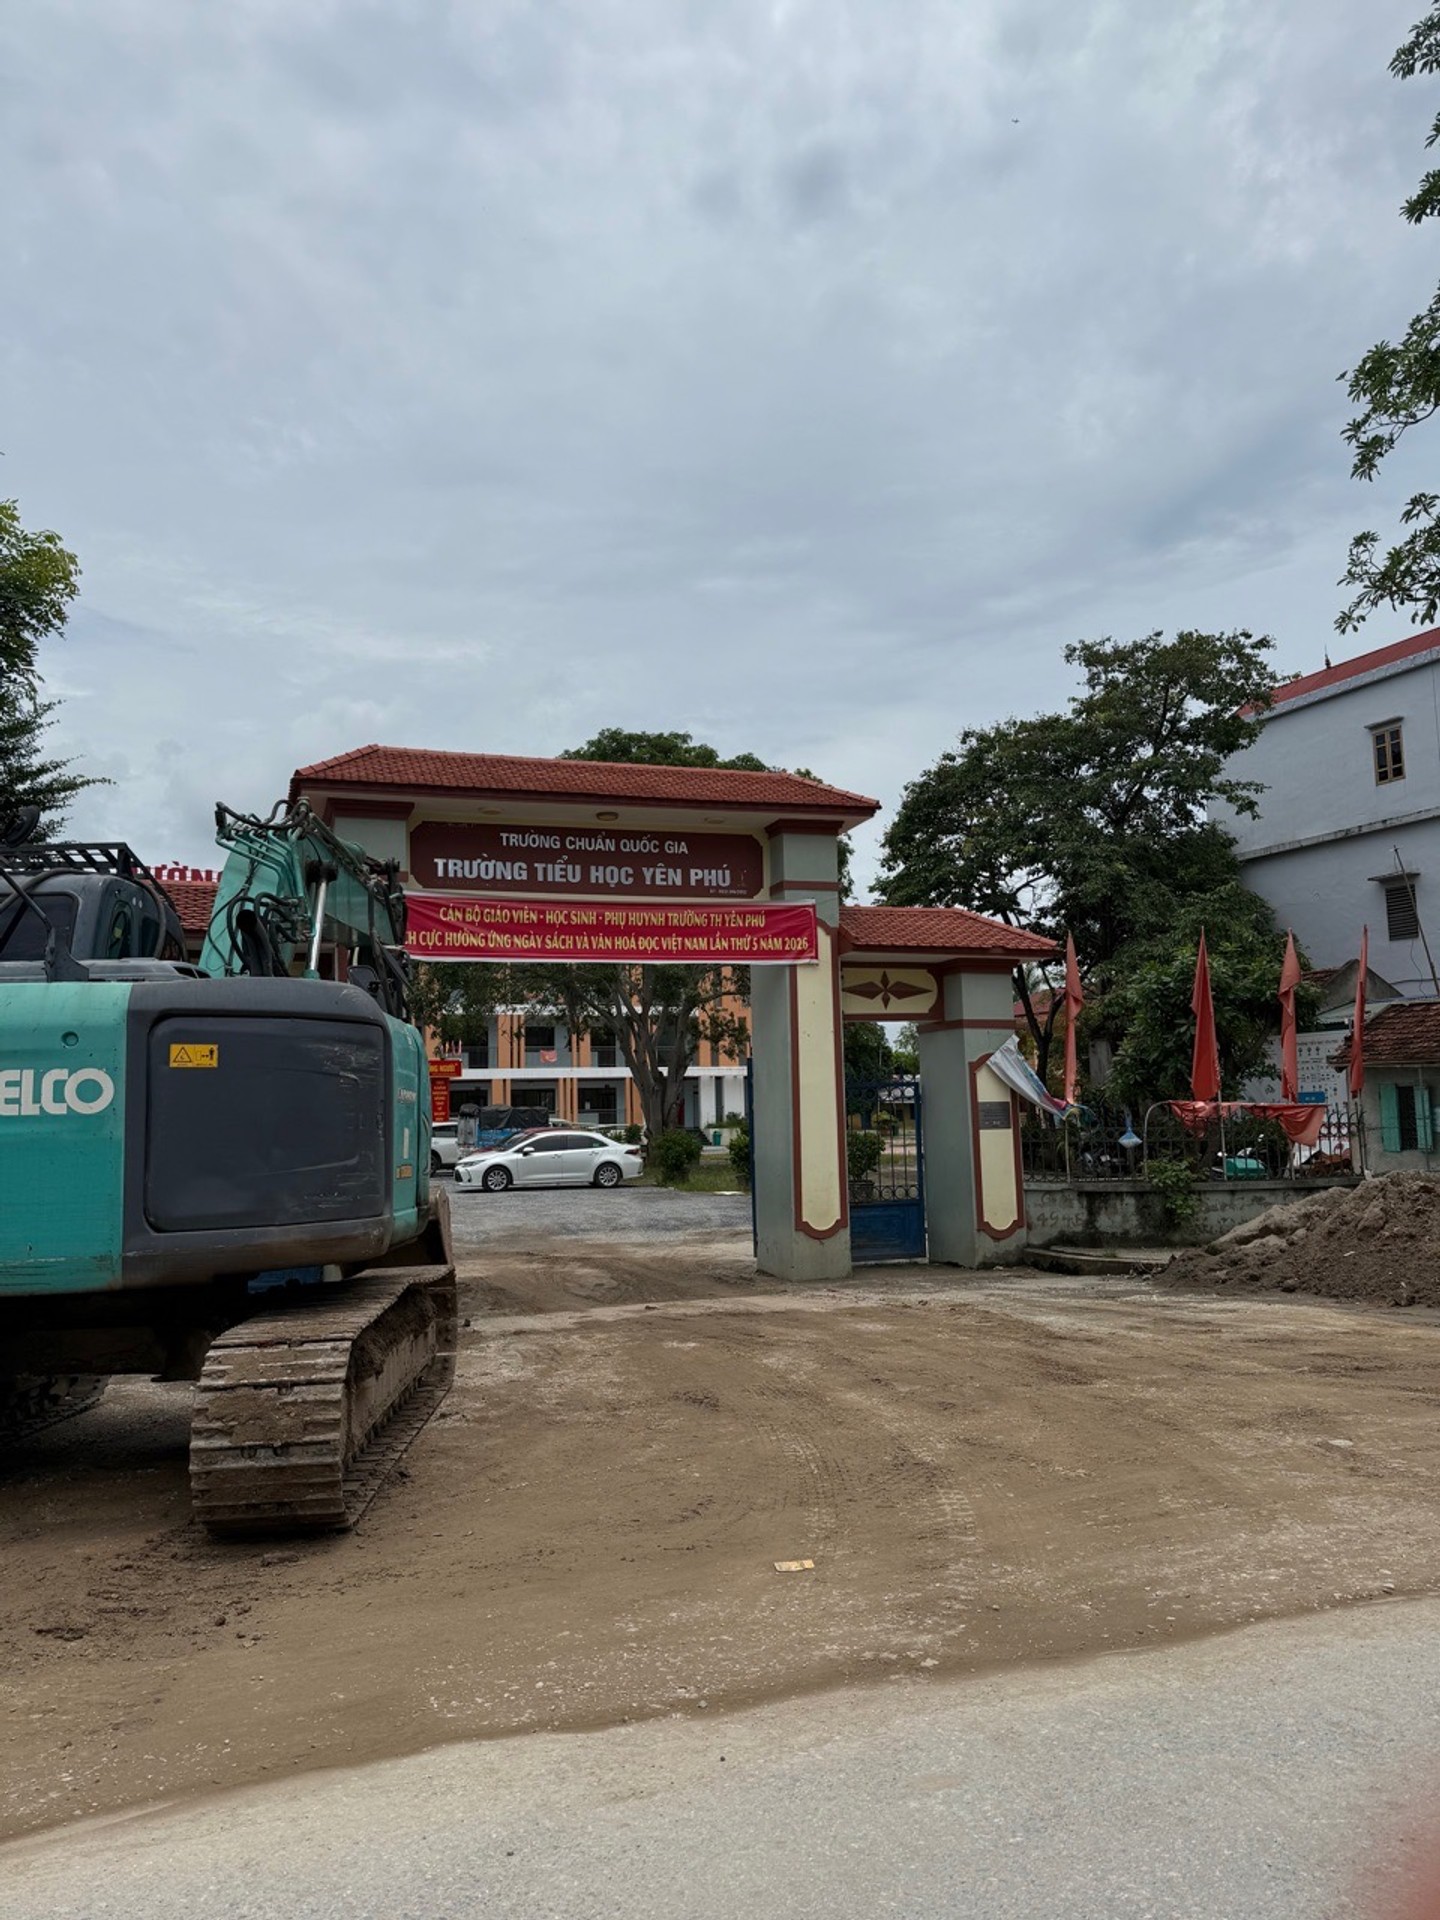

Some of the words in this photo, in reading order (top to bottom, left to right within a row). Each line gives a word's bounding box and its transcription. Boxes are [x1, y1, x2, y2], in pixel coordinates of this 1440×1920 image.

[500, 829, 561, 849] TRƯỜNG
[566, 831, 616, 852] CHUẨN
[620, 833, 659, 855] QUỐC
[665, 839, 688, 855] GIA
[433, 853, 528, 881] TRƯỜNG
[534, 854, 581, 883] TIỂU
[589, 866, 634, 888] HỌC
[641, 862, 682, 887] YÊN
[689, 864, 732, 888] PHÚ
[465, 904, 481, 926] BỘ
[483, 904, 510, 923] GIÁO
[513, 906, 538, 924] VIÊN
[546, 911, 568, 928] HỌC
[571, 911, 597, 925] SINH
[604, 911, 626, 930] PHỤ
[628, 912, 665, 926] HUYNH
[667, 909, 708, 927] TRƯỜNG
[709, 913, 722, 927] TH
[724, 910, 744, 928] YÊN
[745, 910, 766, 928] PHÚ
[419, 929, 442, 950] CỰC
[488, 930, 511, 948] ỨNG
[513, 930, 543, 949] NGÀY
[545, 931, 573, 950] SÁCH
[575, 931, 589, 949] VÀ
[614, 932, 637, 950] HOÁ
[637, 935, 660, 954] ĐỌC
[661, 933, 683, 954] VIỆT
[684, 937, 707, 950] NAM
[709, 931, 730, 951] LẦN
[730, 934, 750, 951] THỨ
[752, 938, 758, 951] 5
[784, 937, 809, 951] 2026
